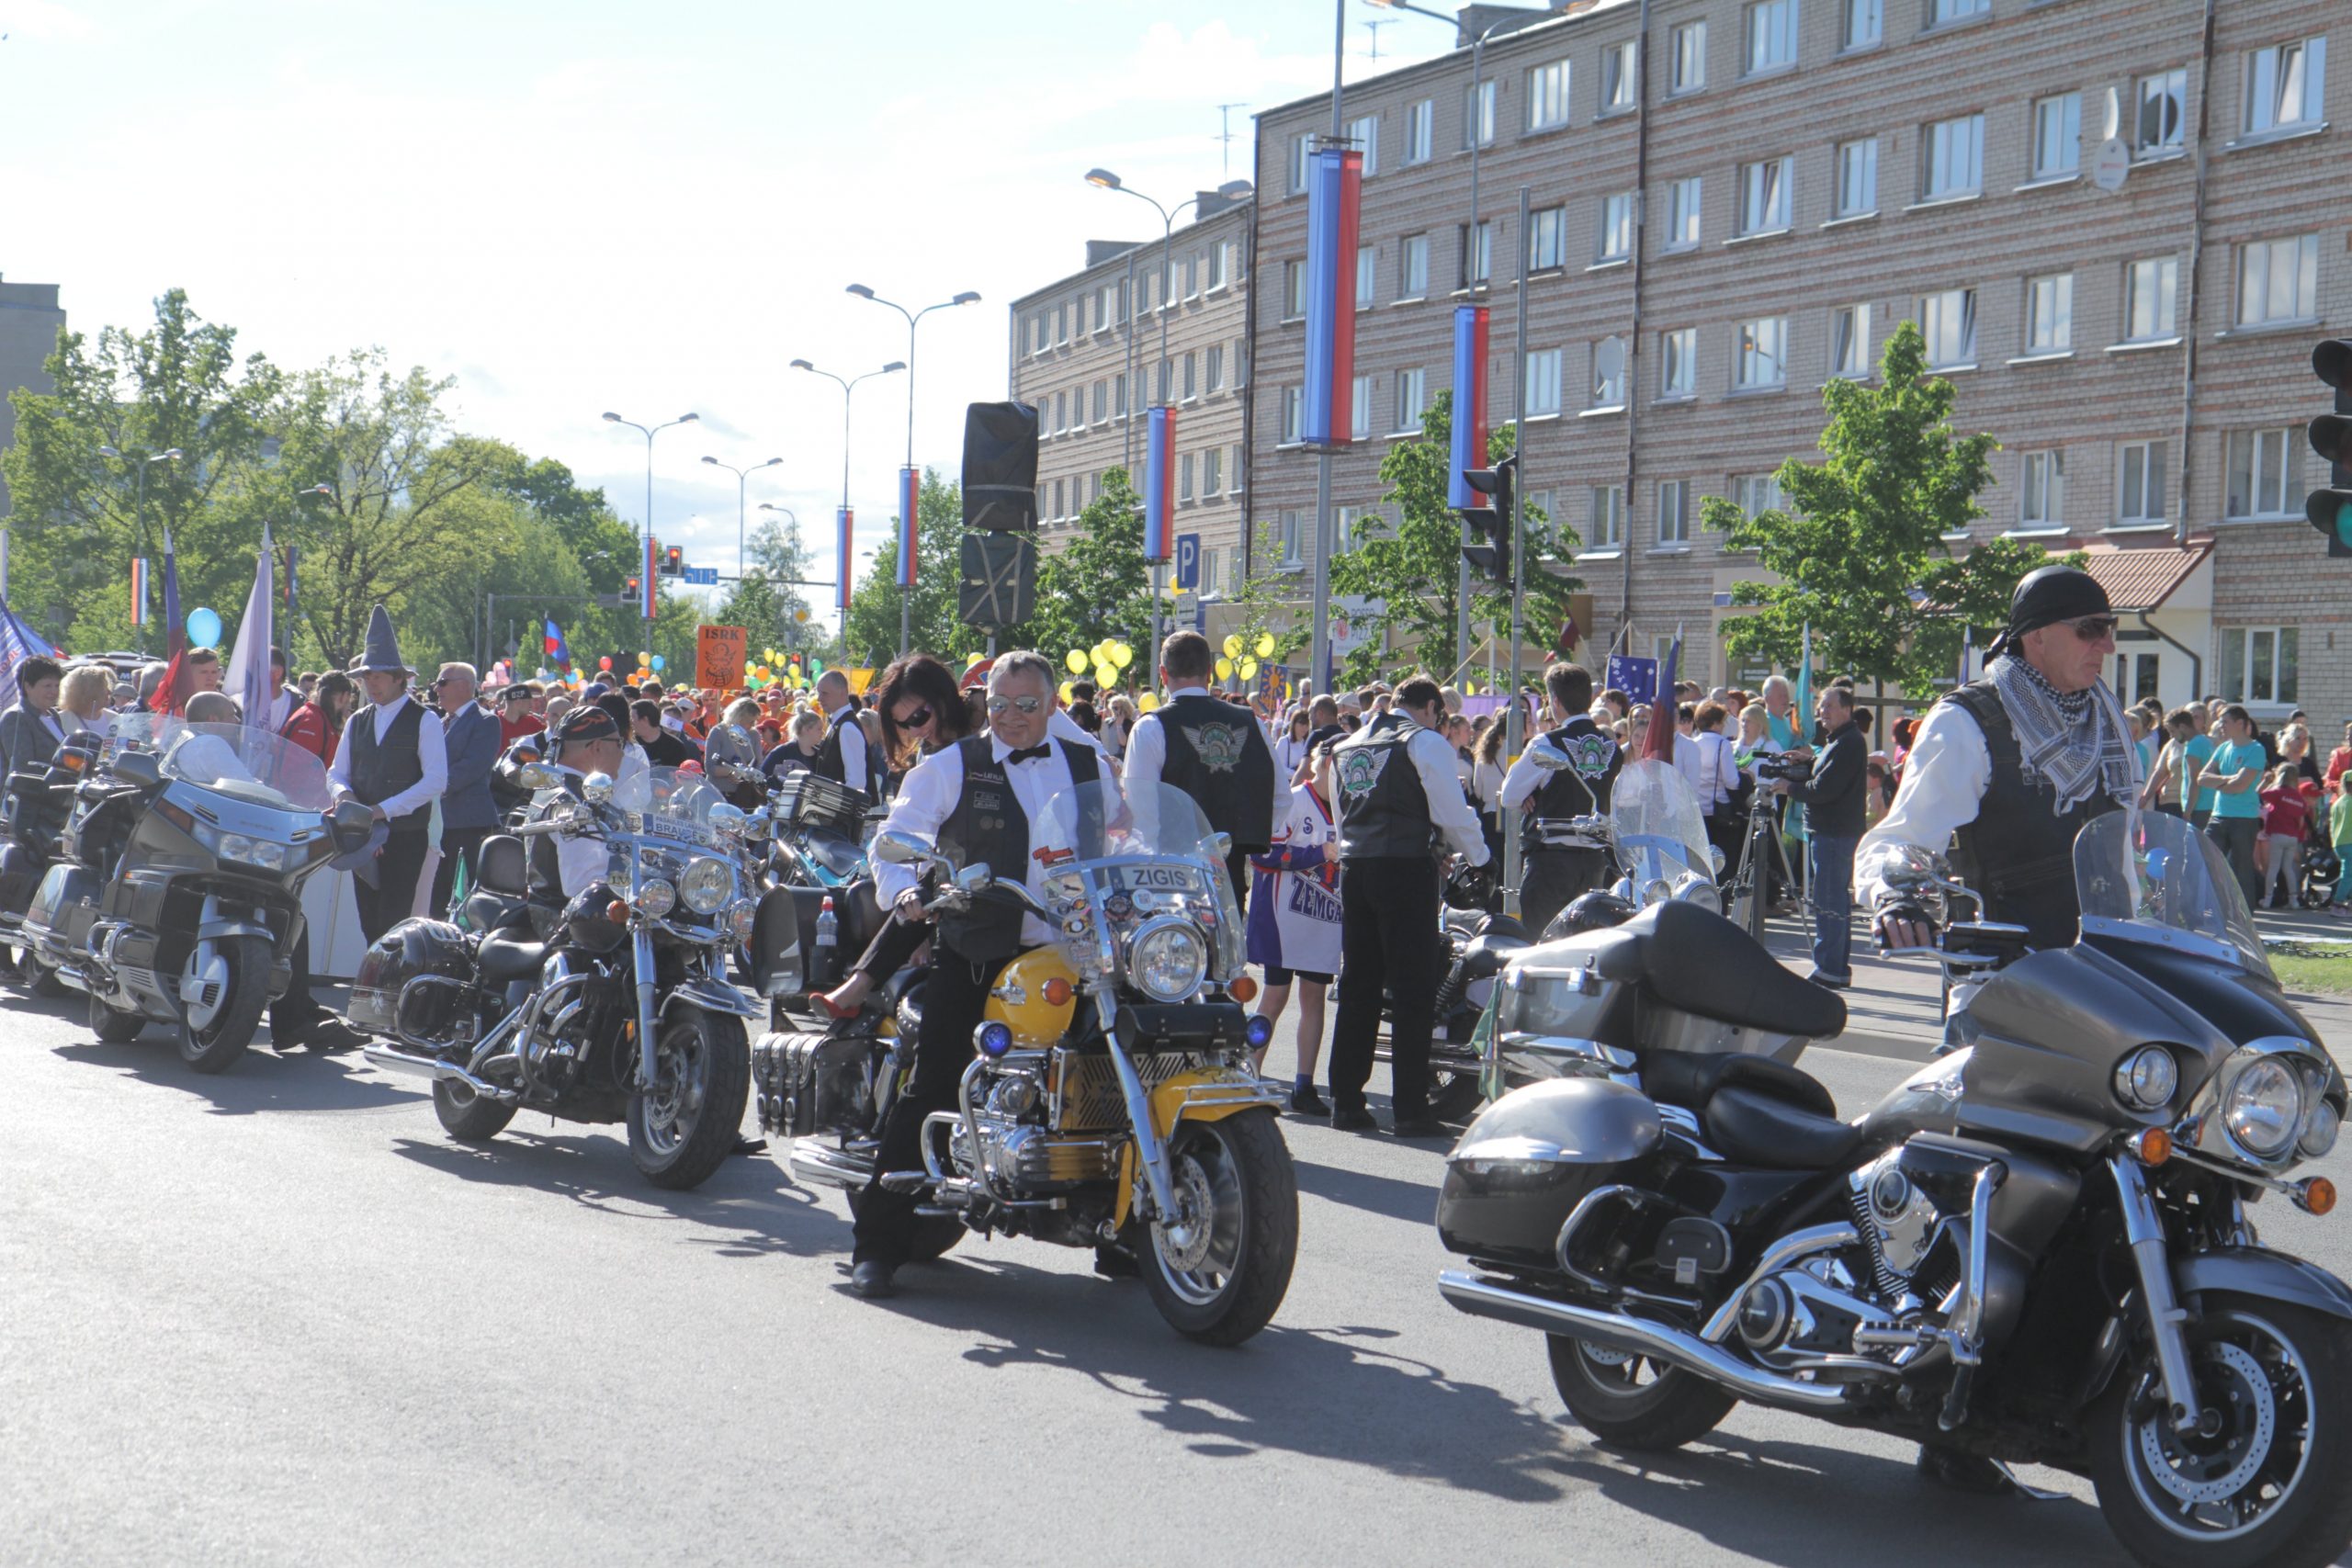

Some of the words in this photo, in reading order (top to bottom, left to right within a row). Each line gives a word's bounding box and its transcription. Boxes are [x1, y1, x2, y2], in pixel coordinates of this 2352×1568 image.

[1182, 540, 1194, 582] P
[705, 628, 739, 640] ISRK
[1303, 816, 1313, 834] S
[1133, 869, 1187, 886] ZIGIS
